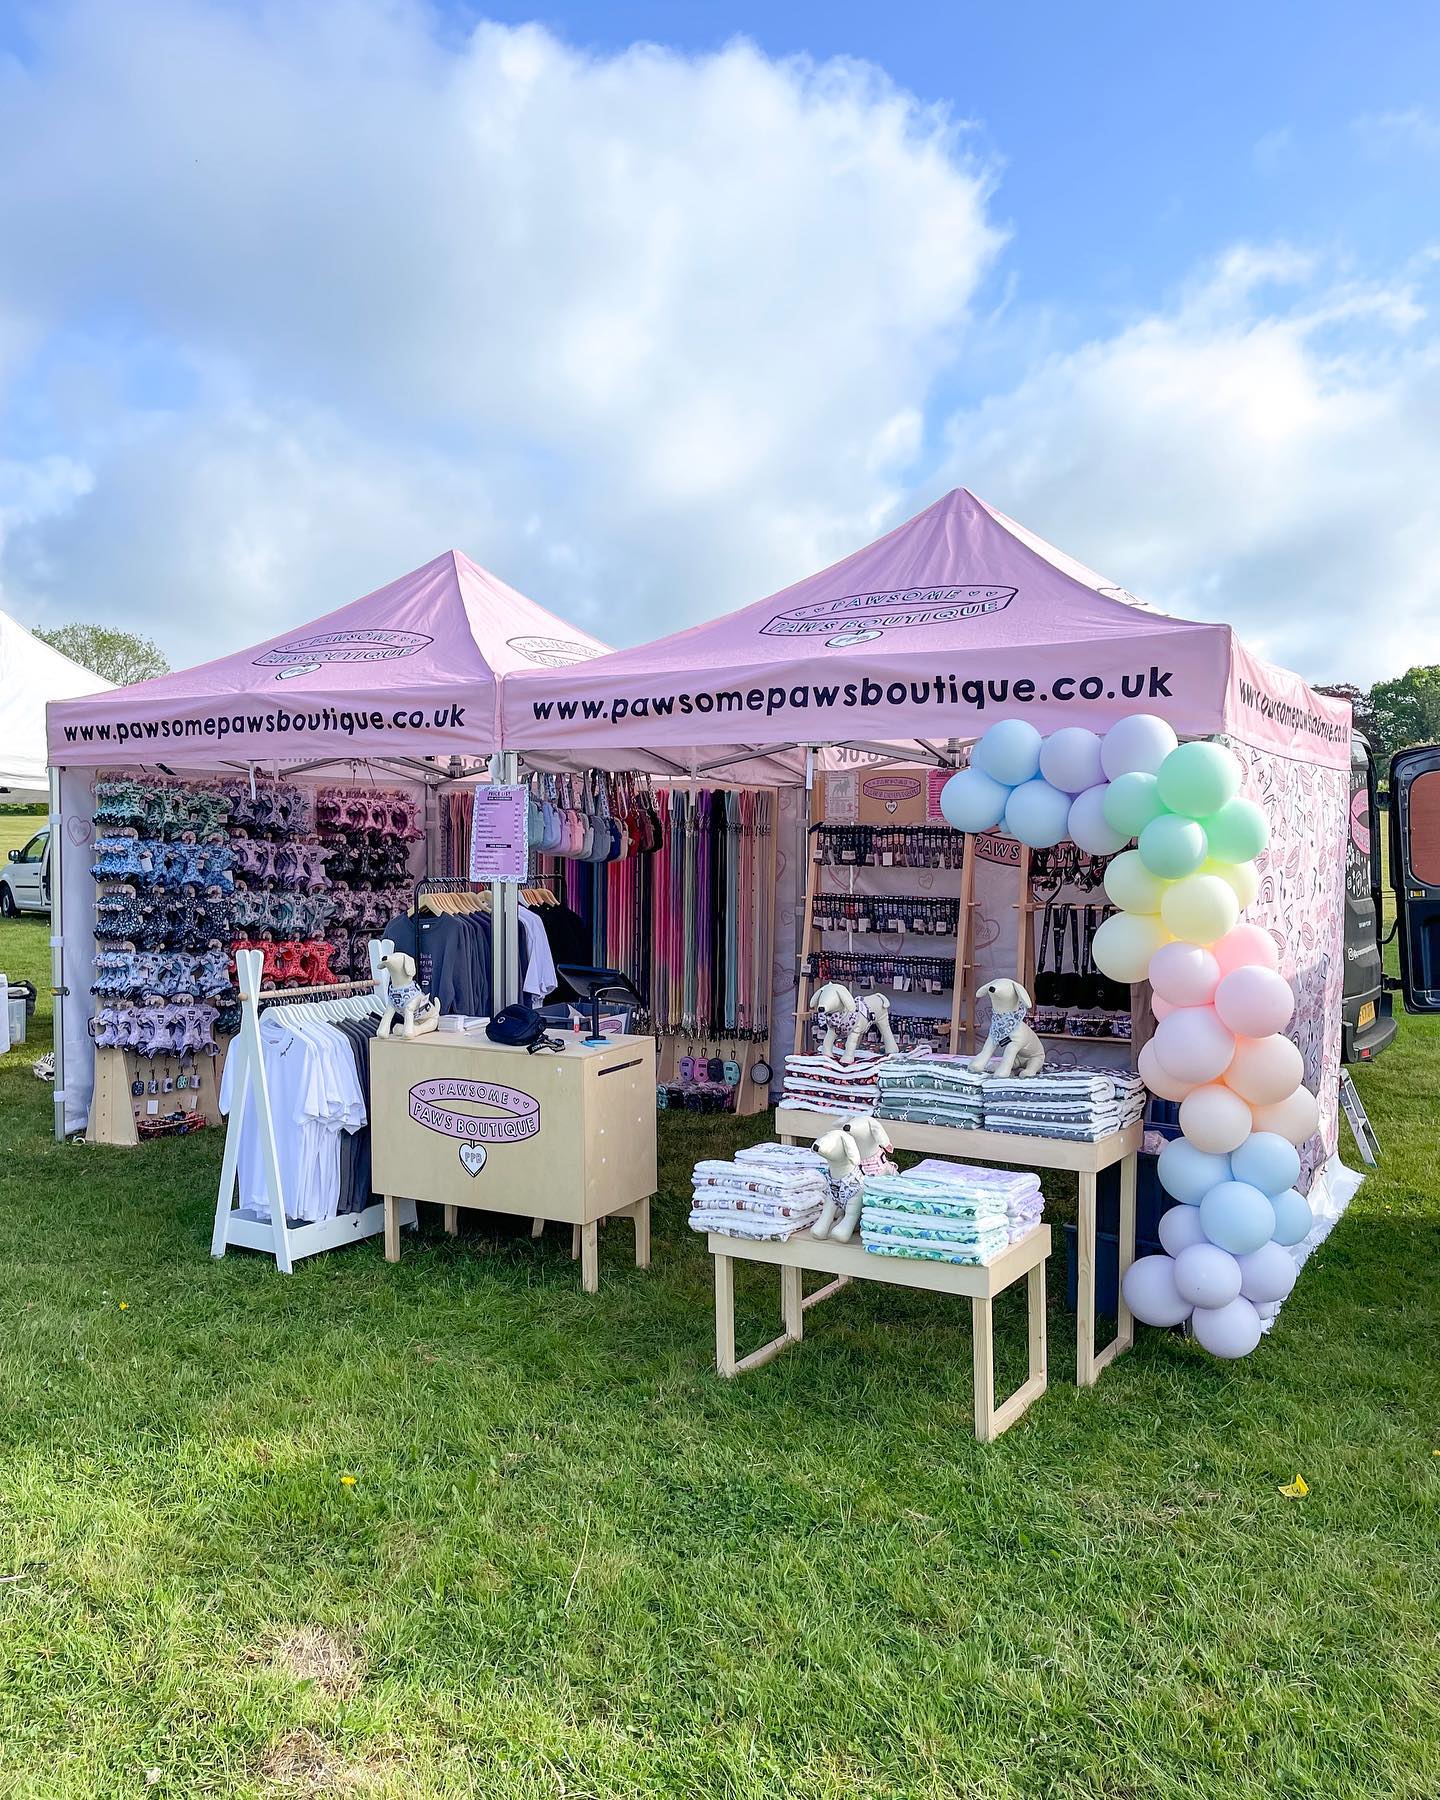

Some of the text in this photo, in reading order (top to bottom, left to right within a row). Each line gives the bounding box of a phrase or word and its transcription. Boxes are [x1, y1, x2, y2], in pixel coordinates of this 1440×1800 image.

[831, 588, 962, 612] PAWSOME
[769, 600, 999, 633] PAWS BOUTIQUE
[533, 666, 1173, 724] www.pawsomepawsboutique.co.uk
[63, 703, 466, 745] www.pawsomepawsboutique.co.uk
[974, 836, 1021, 860] PAWS
[438, 1083, 511, 1105] PAWSOME
[413, 1102, 537, 1138] PAWS BOUTIQUE
[464, 1151, 483, 1164] PPB
